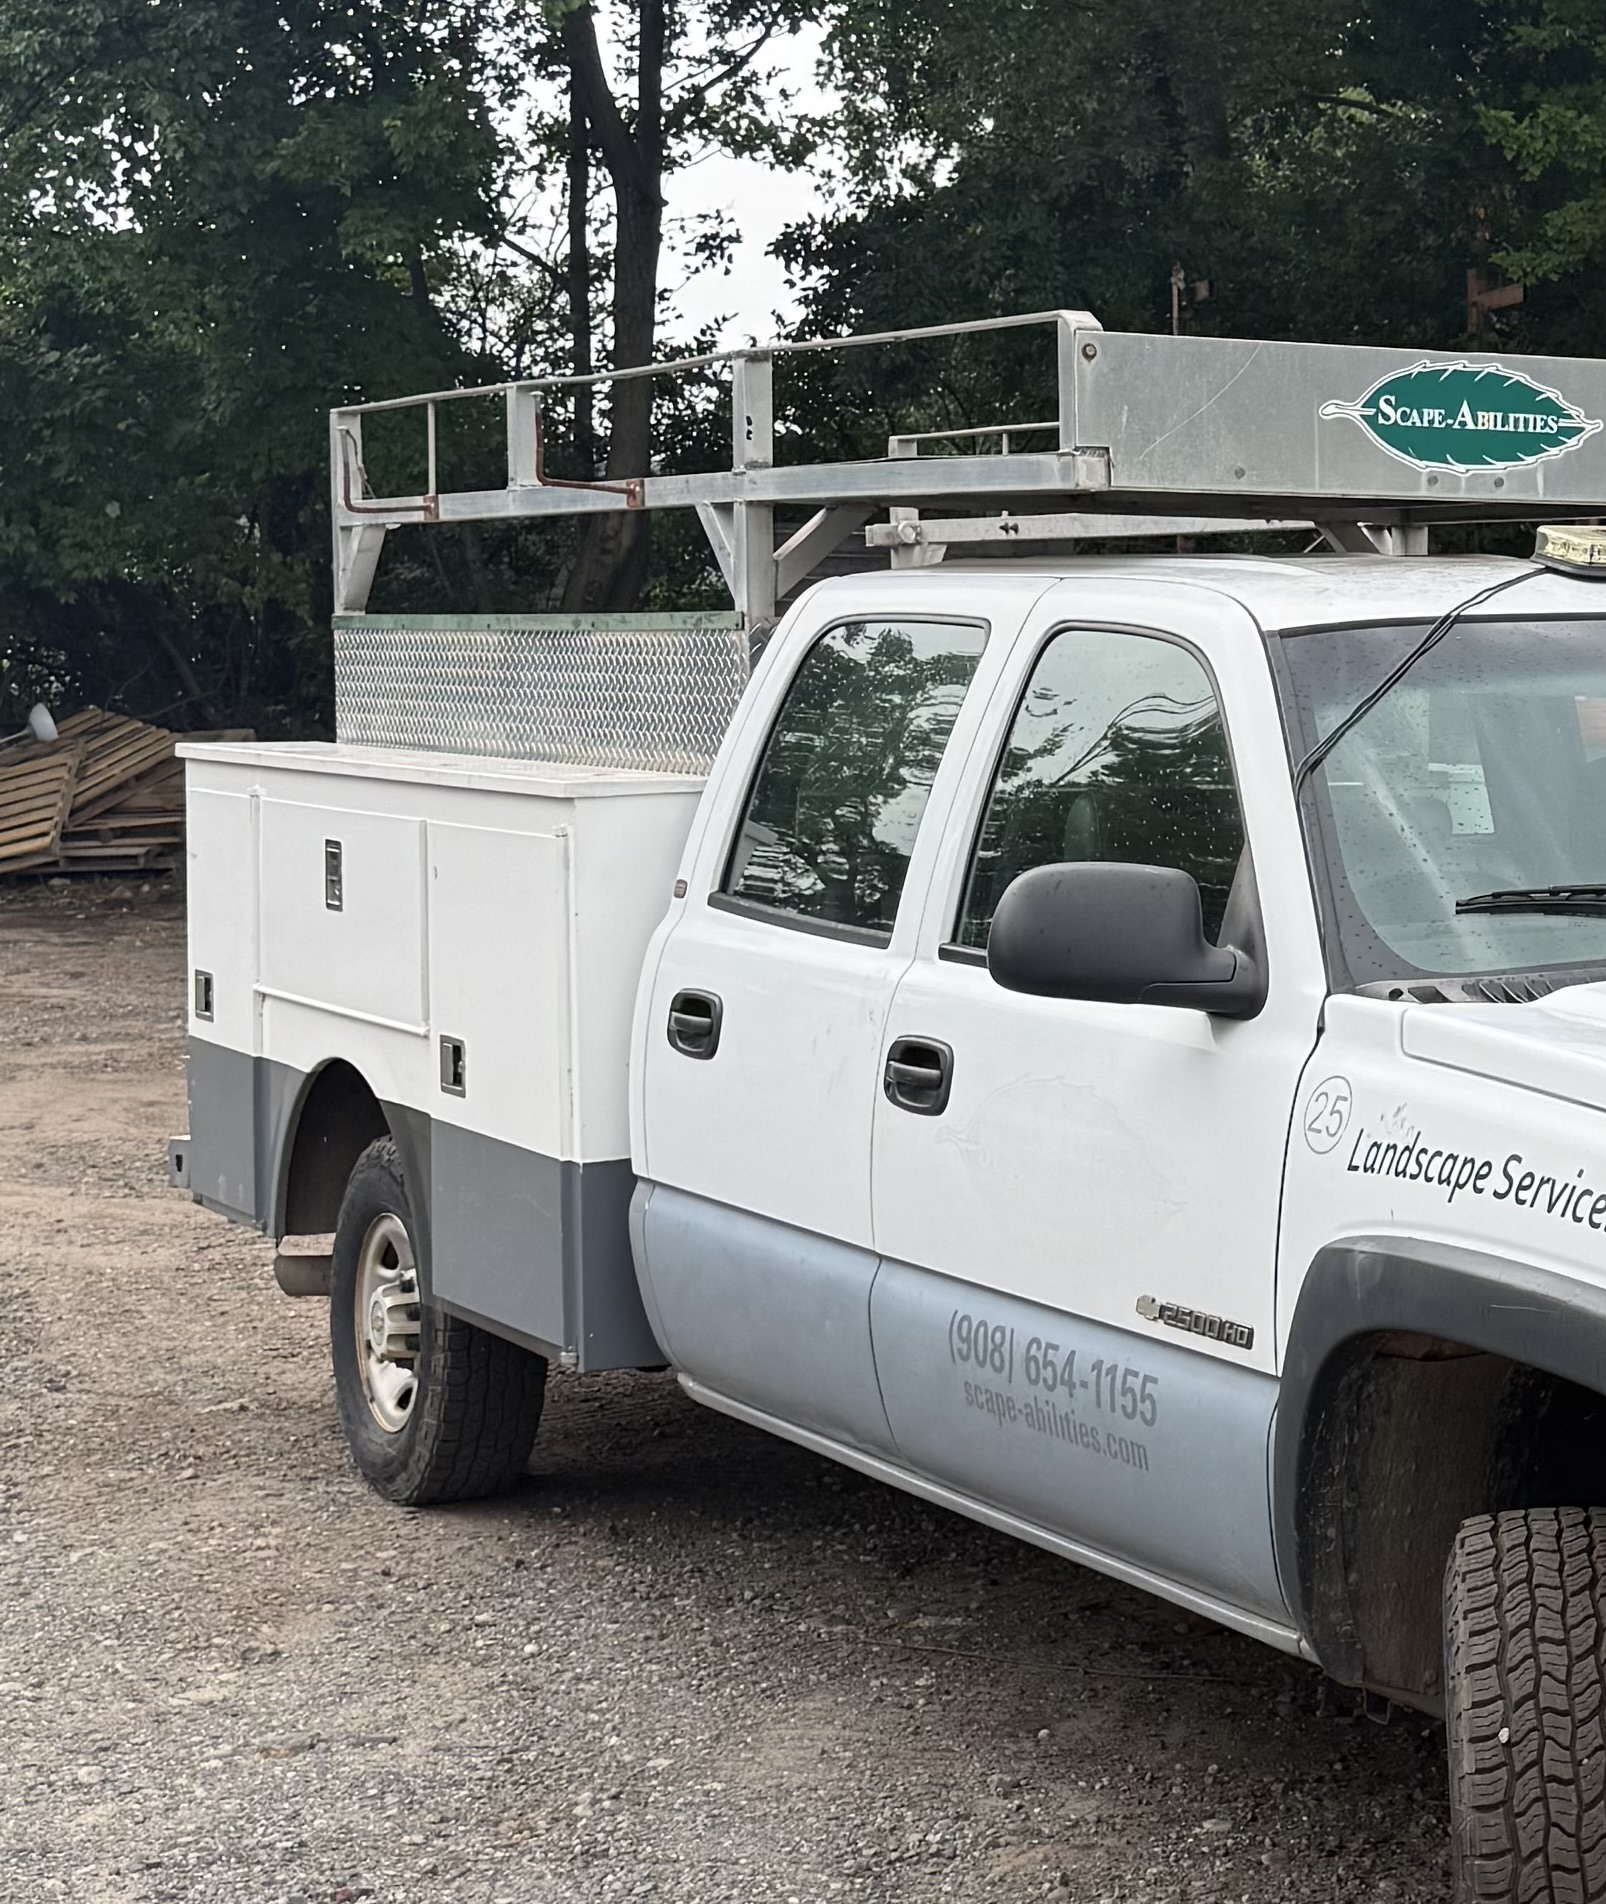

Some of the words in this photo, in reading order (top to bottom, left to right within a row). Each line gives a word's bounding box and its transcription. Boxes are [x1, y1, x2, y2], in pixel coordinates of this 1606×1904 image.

[1306, 1091, 1349, 1138] 25
[1346, 1128, 1494, 1203] Landscape
[948, 1309, 1015, 1384] (908)
[1024, 1336, 1160, 1428] 654-1155
[963, 1379, 1150, 1471] scape-abilities.com
